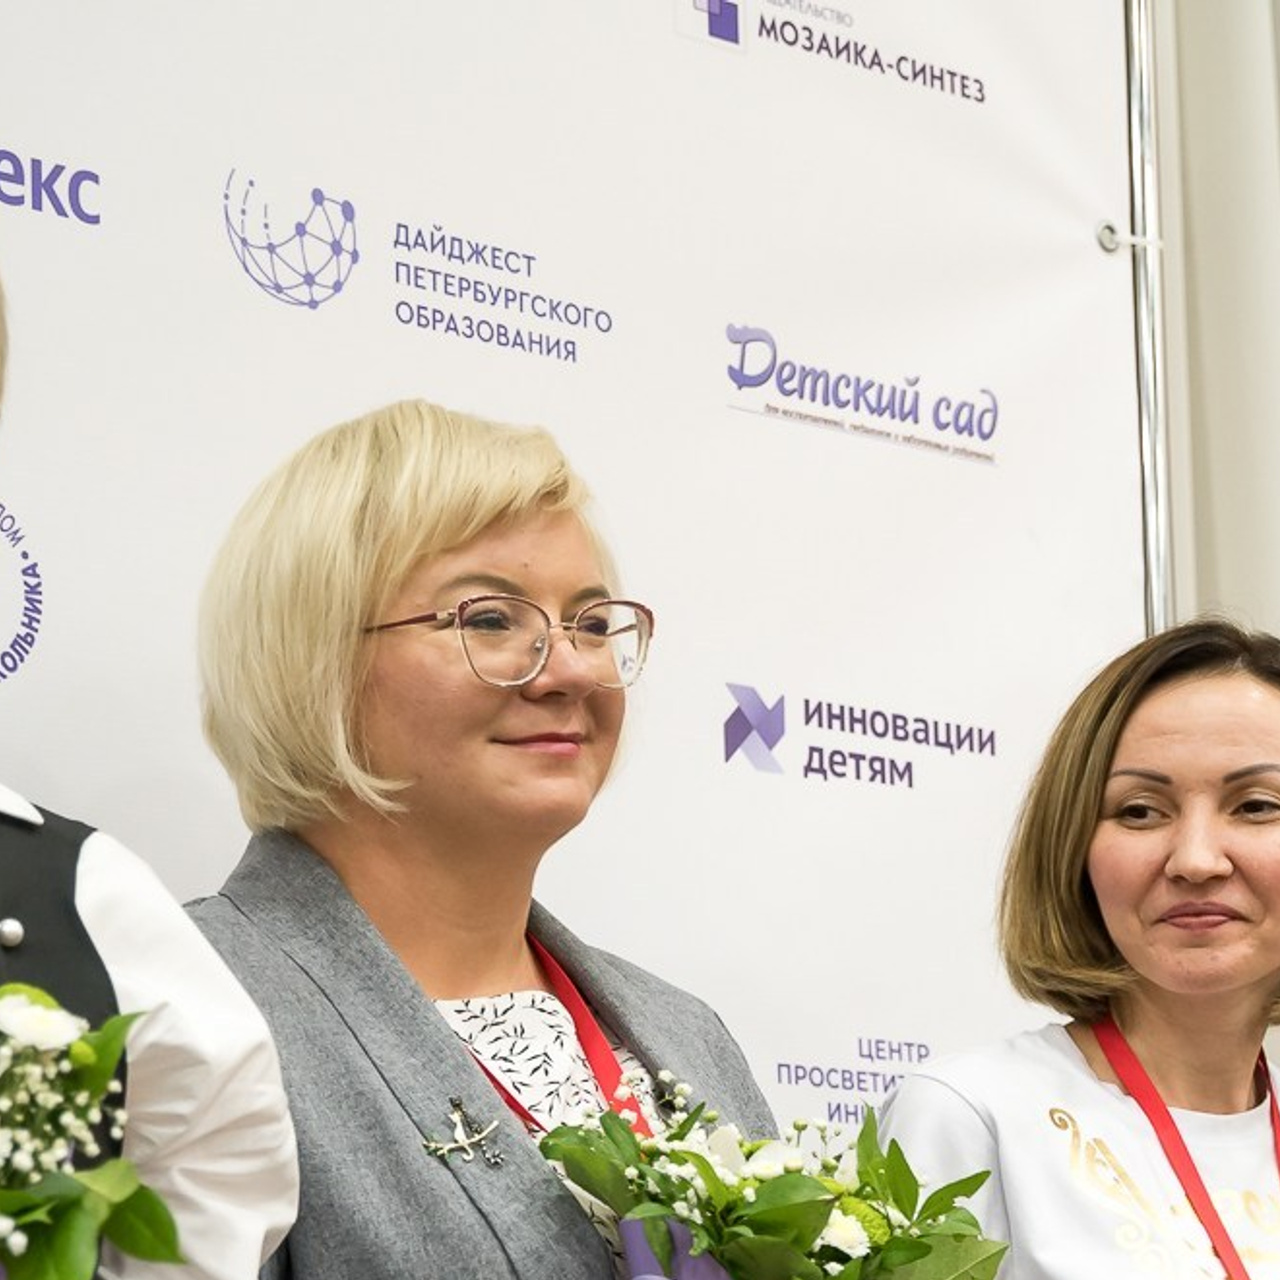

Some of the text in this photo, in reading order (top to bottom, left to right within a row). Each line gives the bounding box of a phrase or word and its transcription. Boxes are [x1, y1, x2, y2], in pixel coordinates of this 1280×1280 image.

[758, 14, 986, 103] МОЗАИКА-СИНТЕЗ
[394, 222, 537, 278] ДАЙДЖЕСТ
[395, 261, 613, 333] ПЕТЕРБУРГСКОГО
[395, 301, 577, 363] ОБРАЗОВАНИЯ
[726, 323, 920, 424] Детский
[932, 389, 998, 441] сад
[803, 746, 913, 788] детям
[777, 1064, 904, 1094] ПРОСВЕТИ
[858, 1038, 930, 1063] ЦЕНТР
